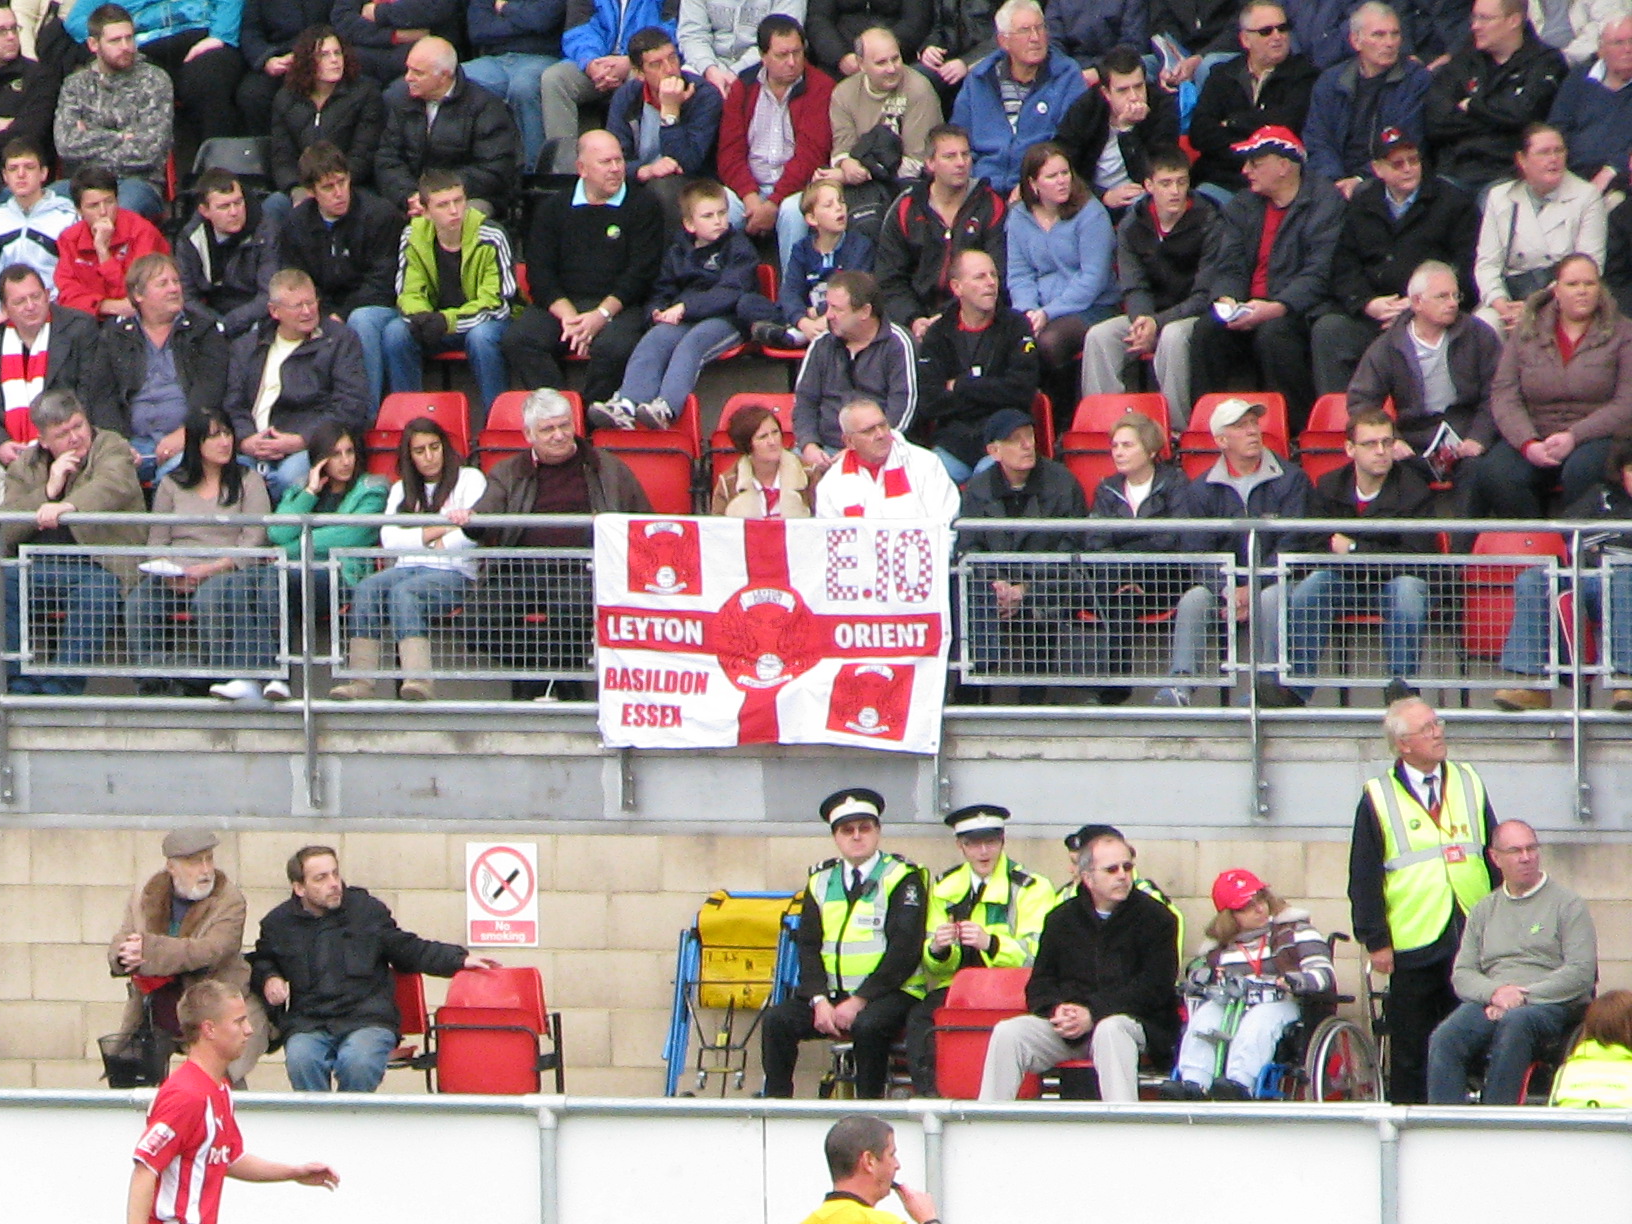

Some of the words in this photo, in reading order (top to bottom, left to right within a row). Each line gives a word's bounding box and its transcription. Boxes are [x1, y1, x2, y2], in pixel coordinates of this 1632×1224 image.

[608, 615, 703, 646] LEYTON
[834, 622, 929, 649] ORIENT
[604, 667, 709, 695] BASILDON
[621, 703, 683, 728] ESSEX
[480, 931, 525, 943] smoking
[495, 922, 510, 931] No
